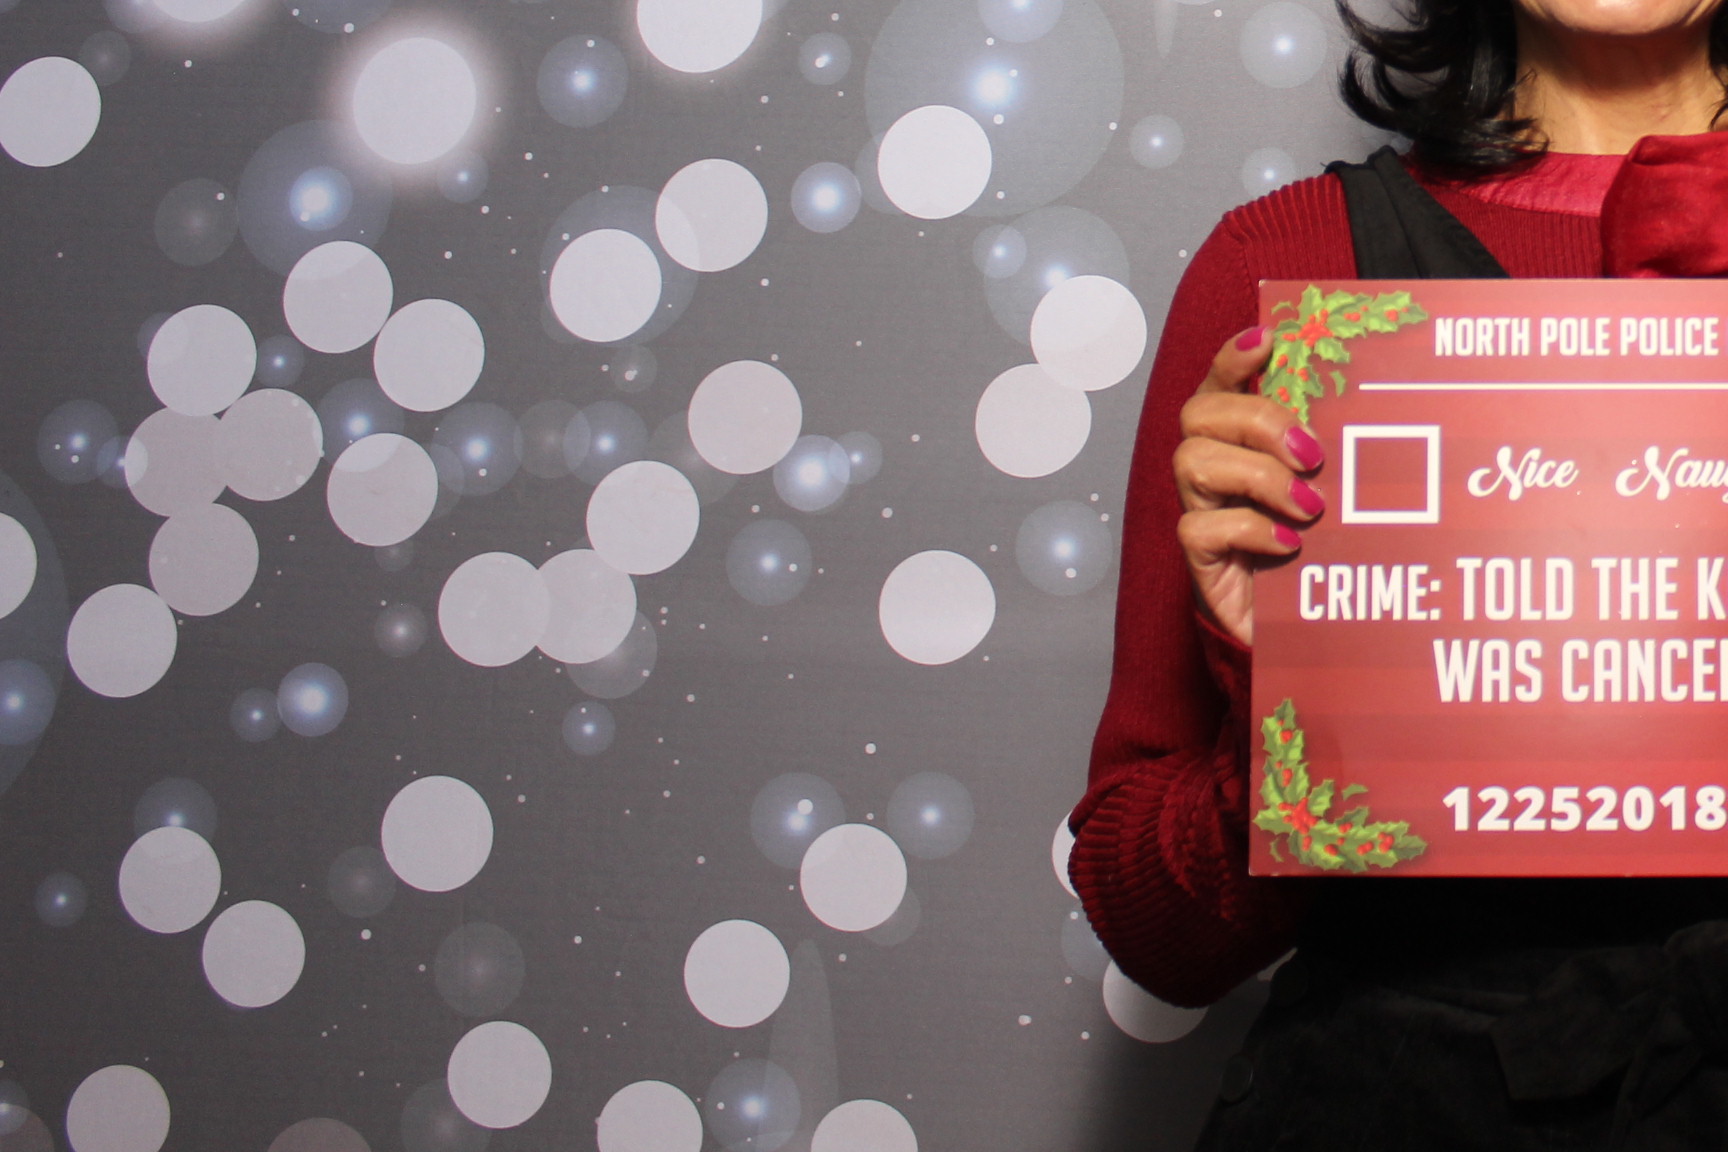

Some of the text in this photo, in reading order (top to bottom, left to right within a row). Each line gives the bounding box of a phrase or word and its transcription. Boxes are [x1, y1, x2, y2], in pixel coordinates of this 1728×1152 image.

[1435, 317, 1531, 356] NORTH
[1540, 317, 1611, 356] POLE
[1620, 317, 1719, 356] POLICE
[1467, 445, 1578, 501] Nice
[1299, 564, 1442, 621] CRIME:
[1456, 557, 1575, 621] TOLD
[1591, 557, 1679, 621] THE
[1433, 638, 1543, 702] WAS
